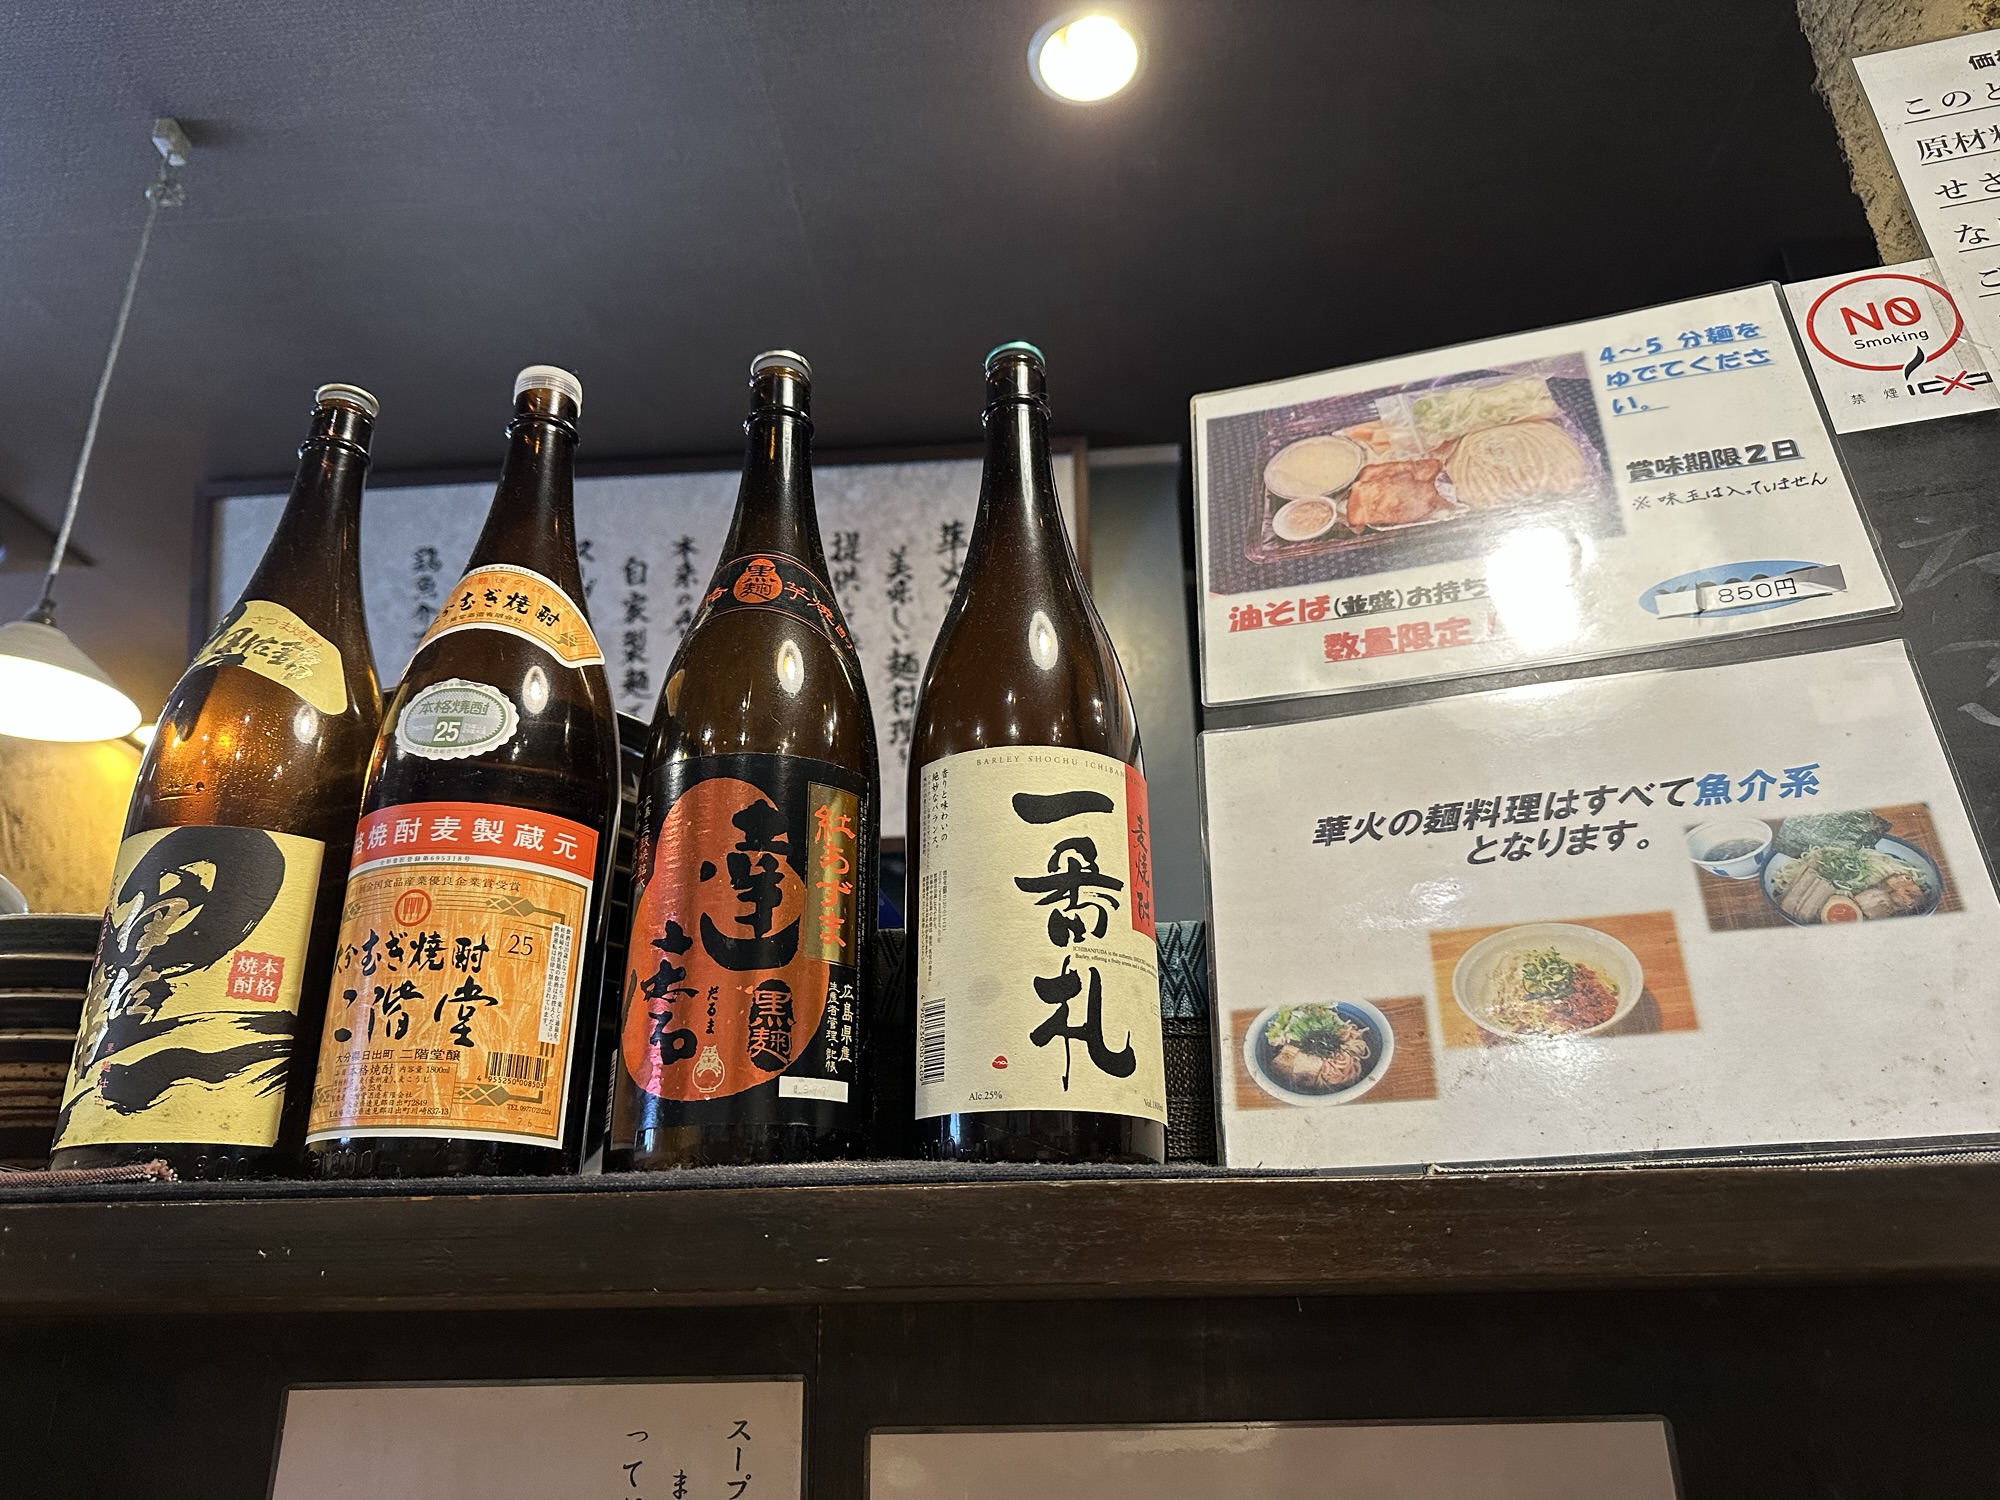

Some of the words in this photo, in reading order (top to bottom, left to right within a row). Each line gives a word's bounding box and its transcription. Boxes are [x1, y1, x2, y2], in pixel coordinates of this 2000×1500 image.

[1954, 217, 2000, 244] な
[1840, 297, 1921, 336] NO
[1854, 327, 1929, 350] Smoking
[1606, 348, 1772, 387] ゆでてくださ
[1612, 396, 1649, 414] い。
[1719, 577, 1797, 604] 850円
[884, 543, 919, 765] 美味しい麺料理
[419, 700, 490, 716] 本格焼酎
[433, 721, 460, 741] 25
[976, 755, 1020, 766] BARLEY
[1028, 755, 1078, 766] SHOCHU
[940, 768, 949, 841] 香りと味わいの
[1465, 822, 1652, 866] となります。
[815, 804, 856, 948] 紅あずま
[507, 934, 534, 956] 25
[233, 955, 259, 995] 焼酎
[256, 957, 279, 998] 本格
[706, 984, 719, 1036] だるま
[838, 984, 853, 1063] 広島県産
[336, 1049, 394, 1063] 大分県日出町
[350, 1064, 393, 1076] 本格焼酎
[399, 1065, 423, 1074] 内容量
[426, 1066, 450, 1075] 1800ml
[487, 1075, 517, 1086] 955250
[519, 1079, 545, 1090] 008503
[507, 1103, 519, 1111] TEL
[968, 1090, 1003, 1101] Alc.25%
[622, 1431, 650, 1500] って
[727, 1420, 752, 1500] スープ
